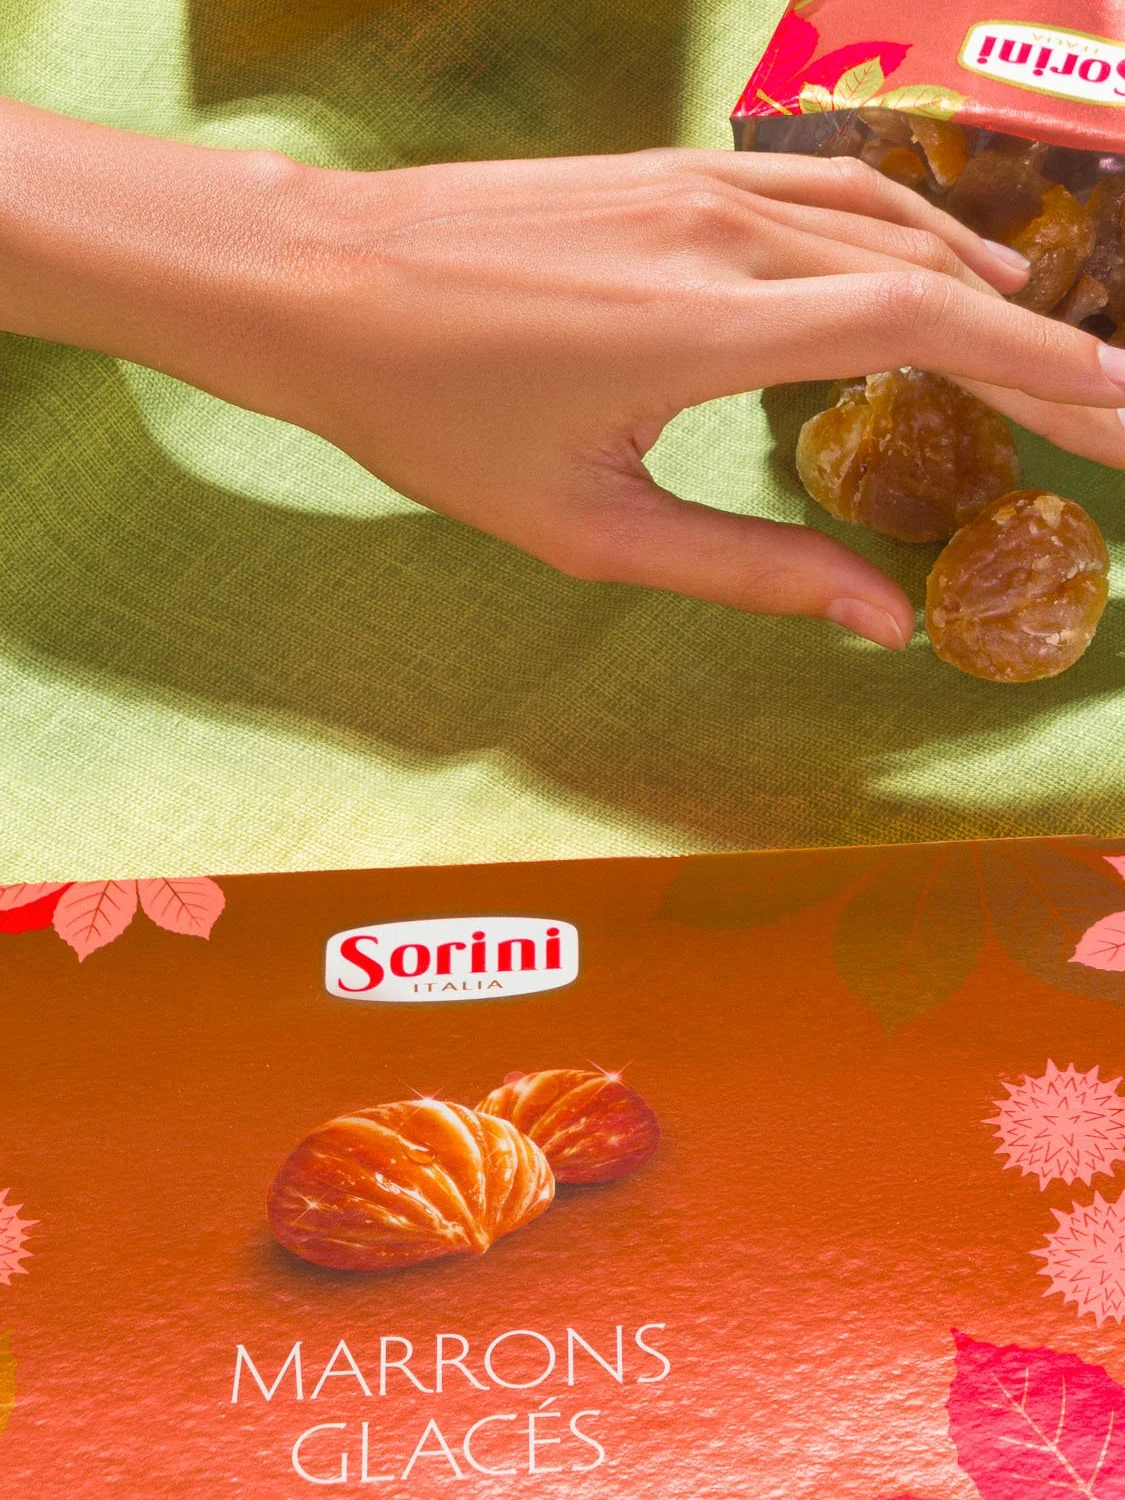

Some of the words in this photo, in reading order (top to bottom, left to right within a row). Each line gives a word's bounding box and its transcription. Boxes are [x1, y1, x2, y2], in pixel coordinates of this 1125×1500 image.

[338, 927, 562, 993] Sorini
[413, 979, 503, 993] ITALIA
[231, 1323, 671, 1403] MARRONS
[291, 1397, 605, 1486] GLACÉS
